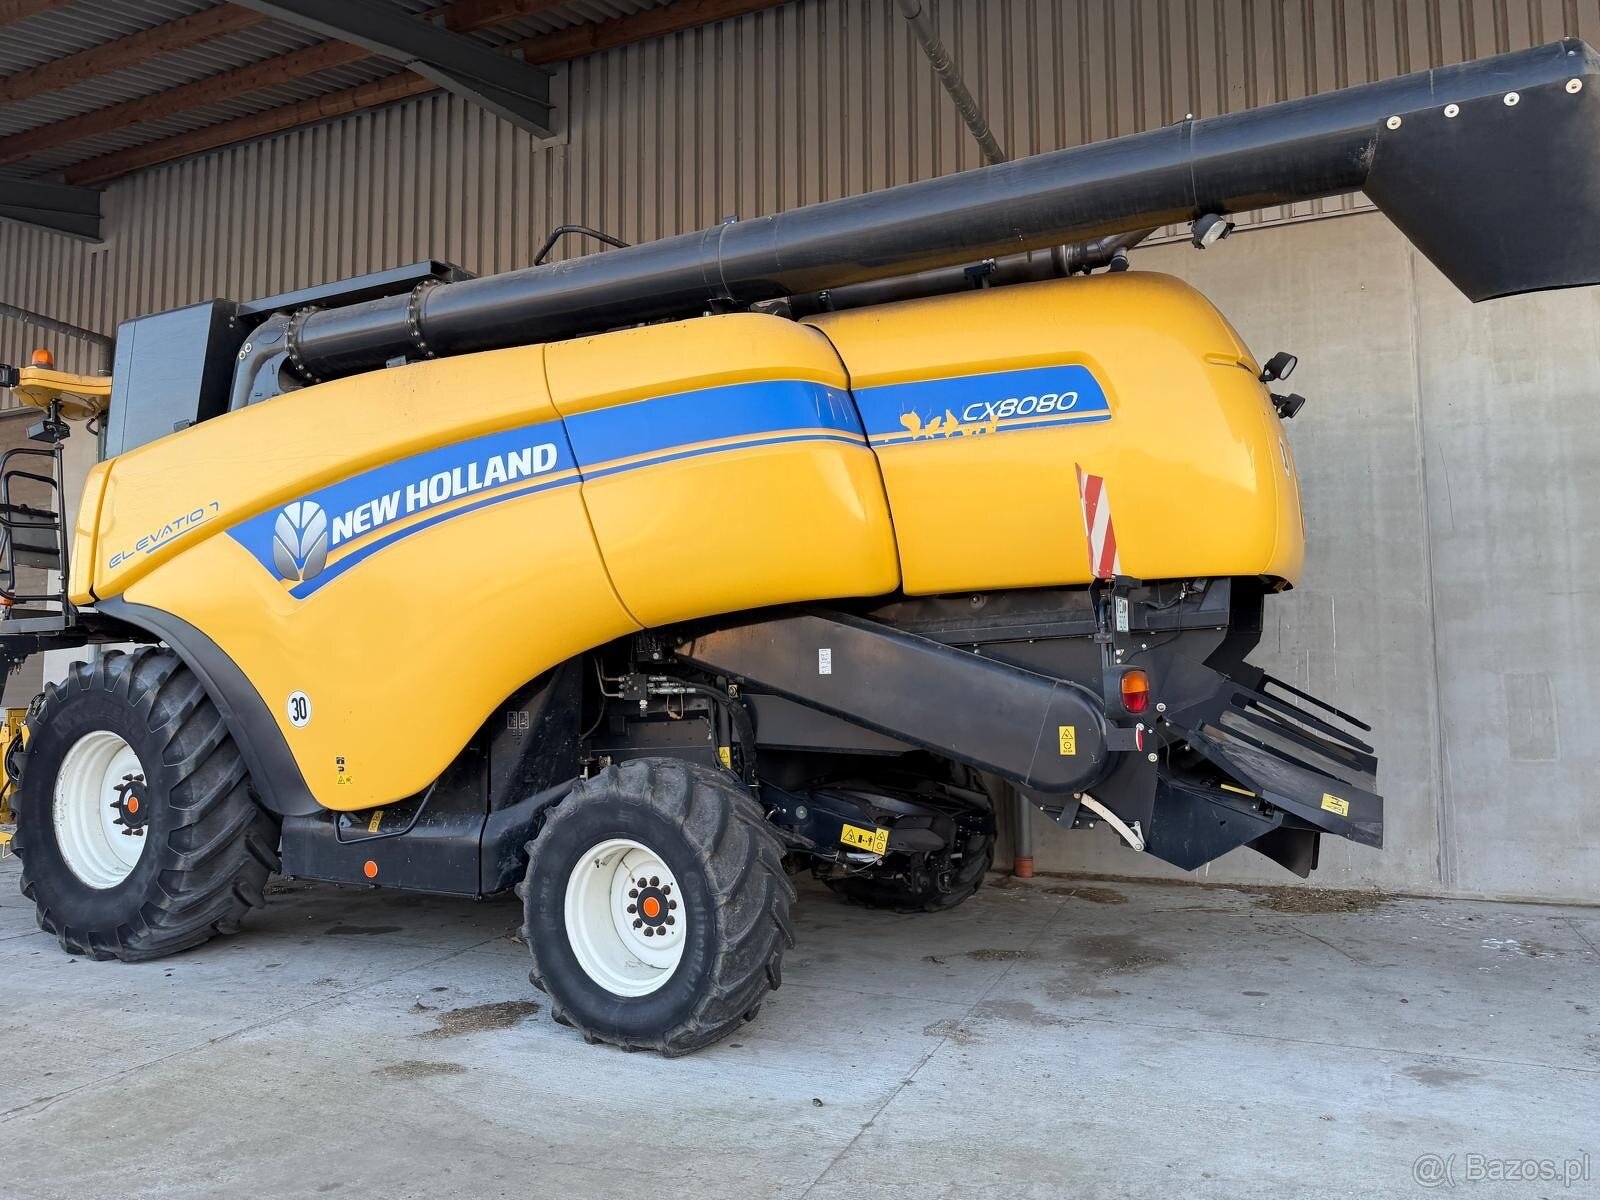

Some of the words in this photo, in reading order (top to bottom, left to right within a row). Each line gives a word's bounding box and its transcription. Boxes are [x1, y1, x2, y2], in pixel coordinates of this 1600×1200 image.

[962, 391, 1078, 422] CX8080
[331, 490, 401, 545] NEW
[406, 442, 558, 513] HOLLAND
[291, 697, 307, 721] 30
